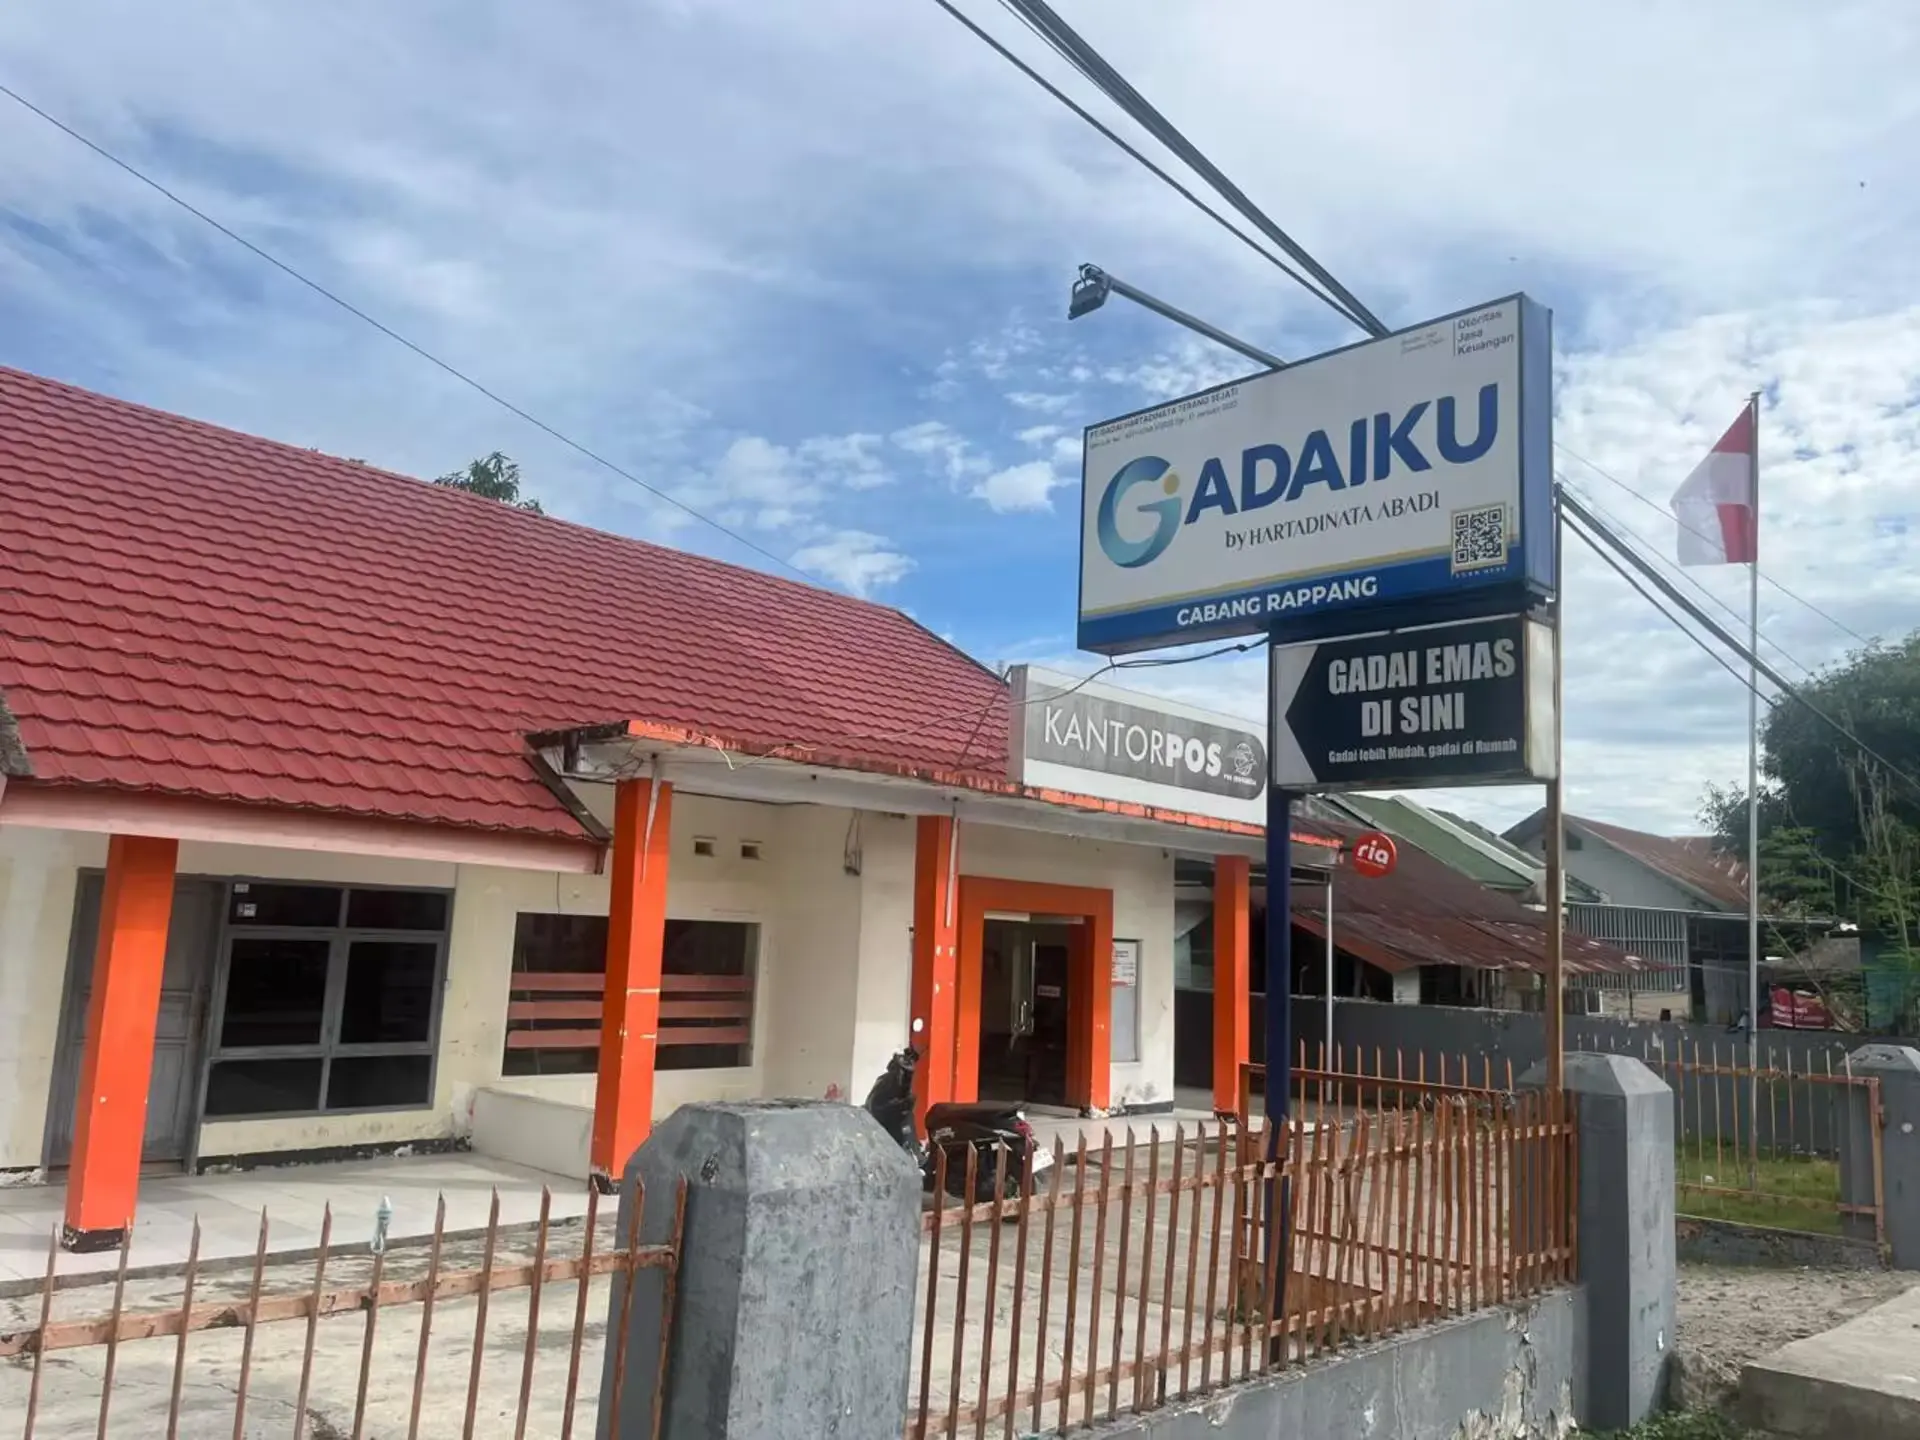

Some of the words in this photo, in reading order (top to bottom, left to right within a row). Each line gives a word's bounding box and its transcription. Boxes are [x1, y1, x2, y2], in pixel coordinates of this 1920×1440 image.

[1457, 309, 1503, 329] Otoritas
[1457, 333, 1515, 355] Keuangan
[1458, 329, 1483, 342] Jasa
[1225, 530, 1246, 550] by
[1249, 505, 1373, 546] HARTADINATA
[1376, 490, 1440, 519] ABADI
[1176, 596, 1261, 626] CABANG
[1266, 576, 1378, 612] RAPPANG
[1328, 650, 1418, 695] GADAI
[1426, 638, 1516, 684] EMAS
[1361, 700, 1393, 737] DI
[1399, 692, 1465, 734] SINI
[1328, 749, 1357, 764] Gadai
[1359, 747, 1386, 762] lebih
[1428, 741, 1460, 759] gadai
[1462, 740, 1474, 754] di
[1357, 840, 1389, 865] ria
